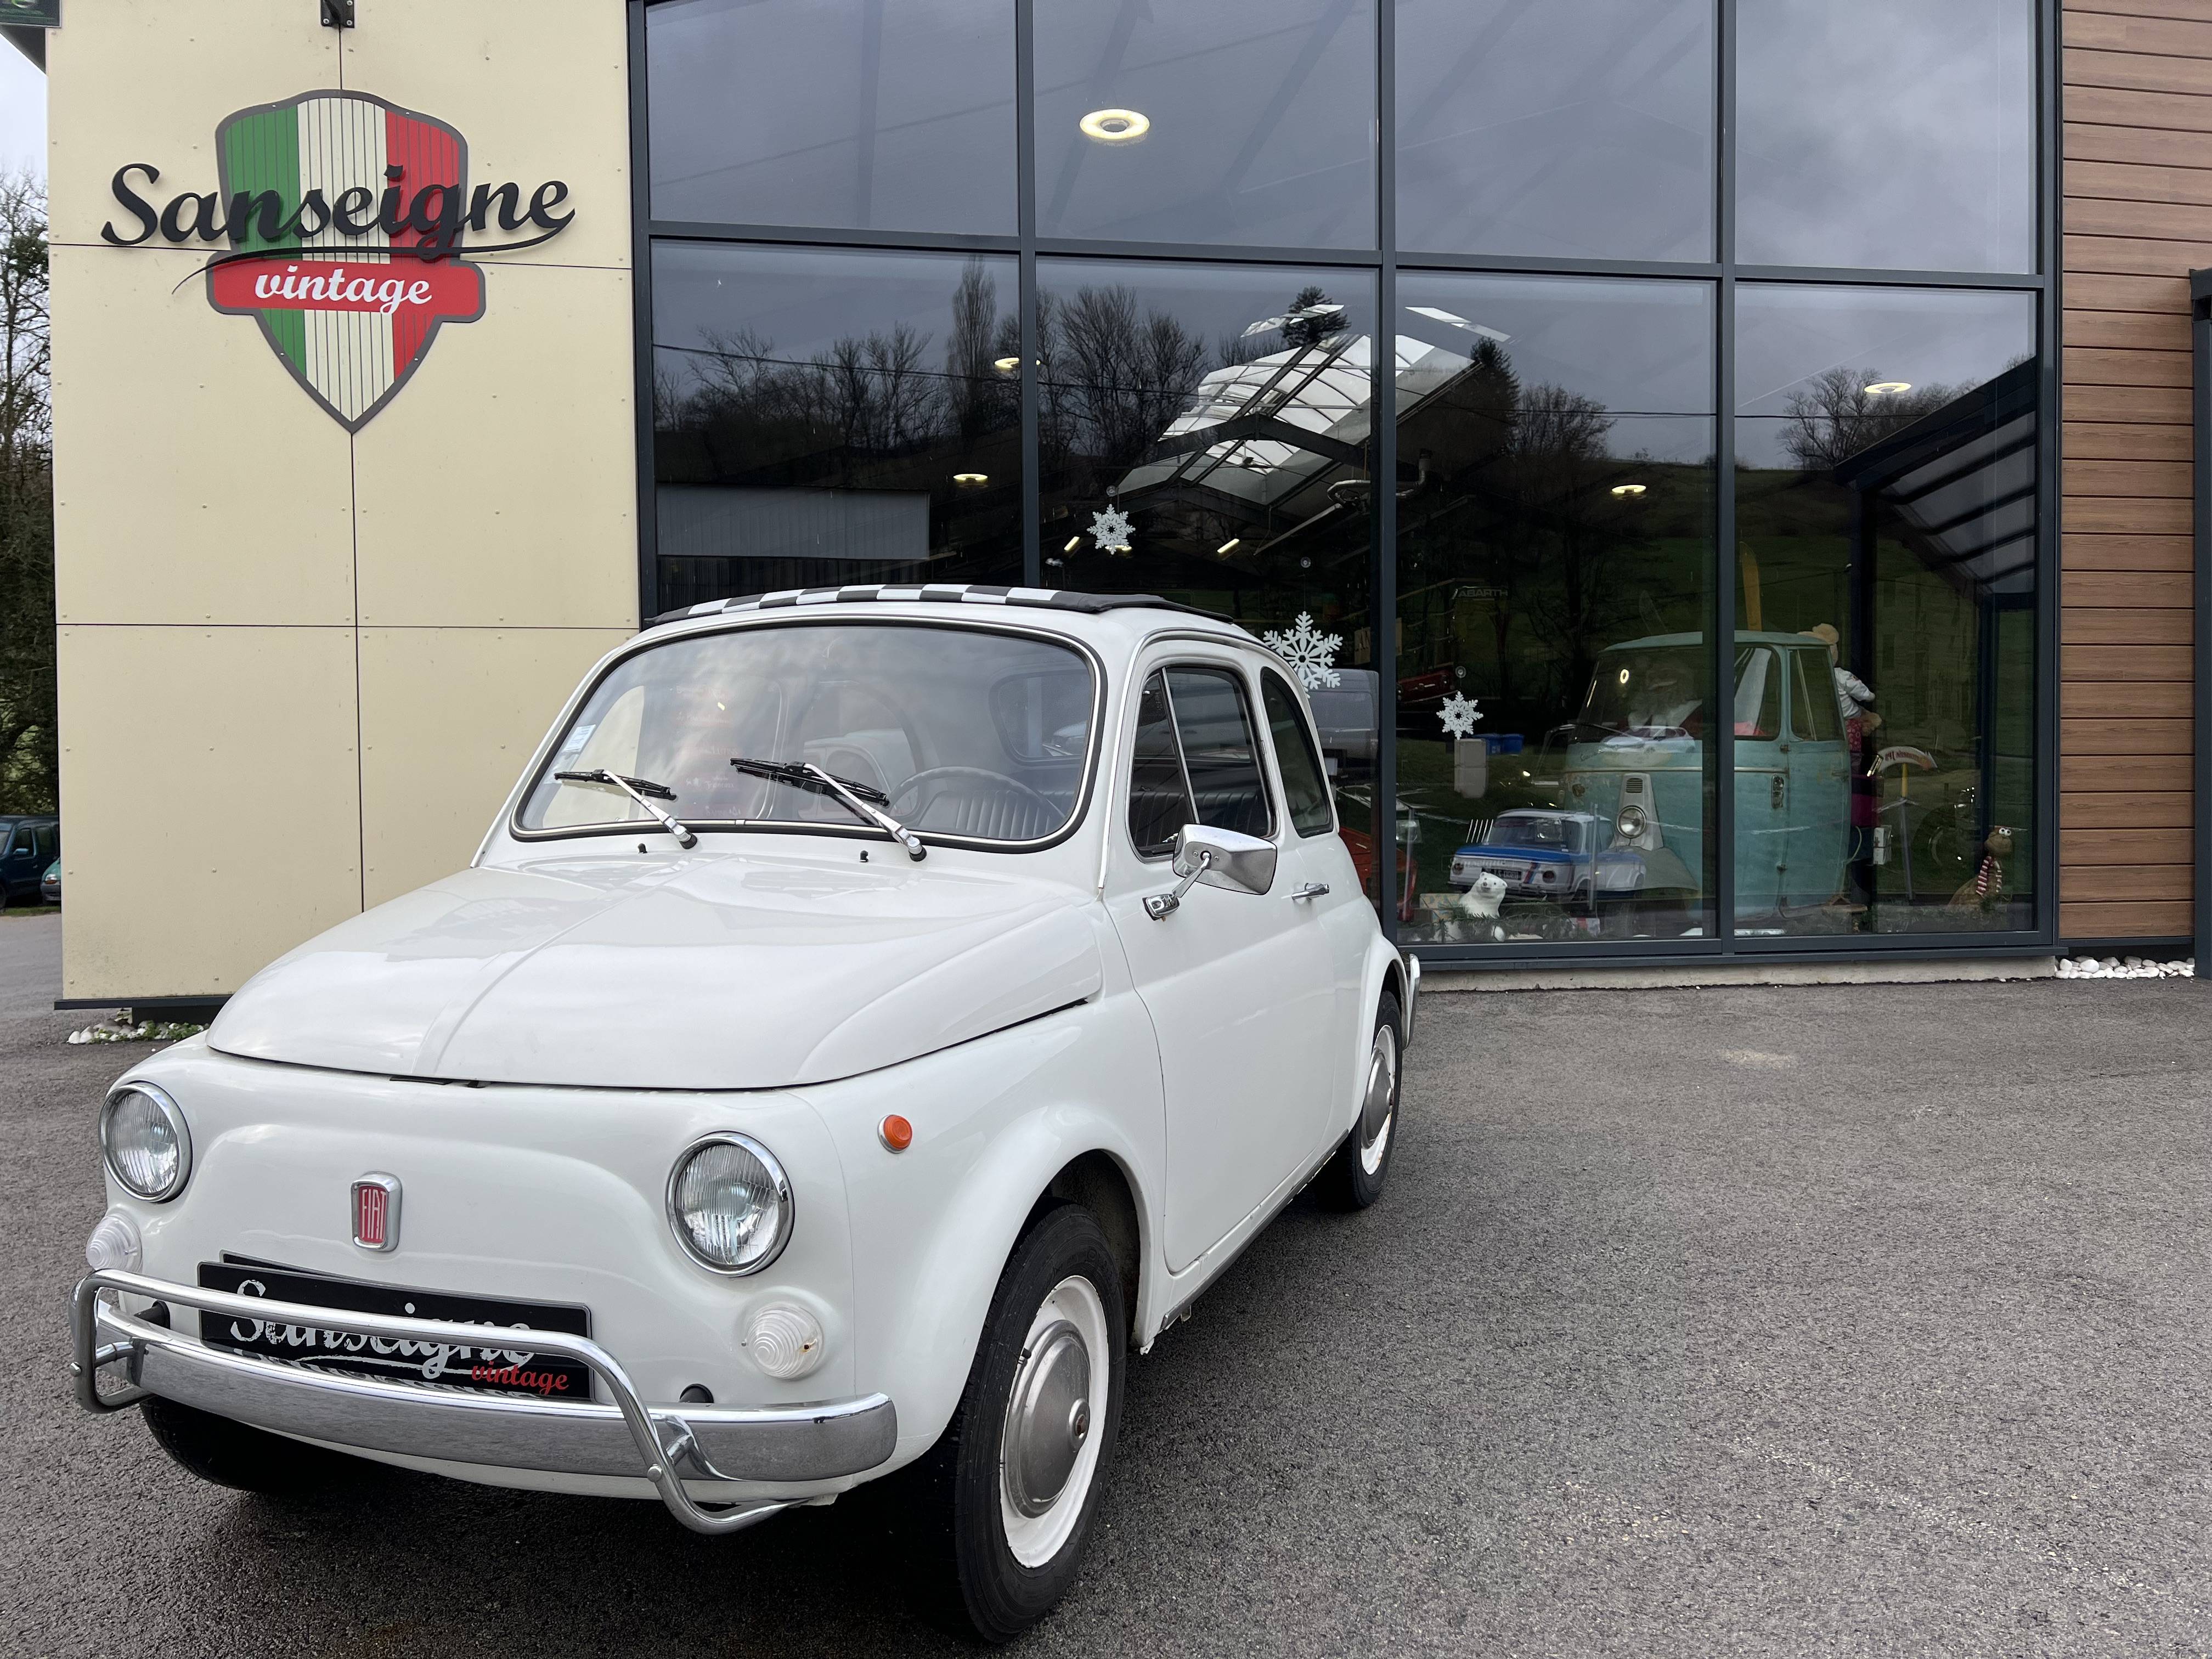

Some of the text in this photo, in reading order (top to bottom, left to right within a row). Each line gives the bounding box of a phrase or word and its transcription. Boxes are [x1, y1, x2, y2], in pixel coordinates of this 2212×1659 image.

[100, 163, 575, 262] Sanseigne
[255, 266, 432, 314] vintage
[1458, 589, 1509, 597] ABARTH
[362, 1189, 387, 1239] FIAT
[471, 1360, 569, 1396] vintage
